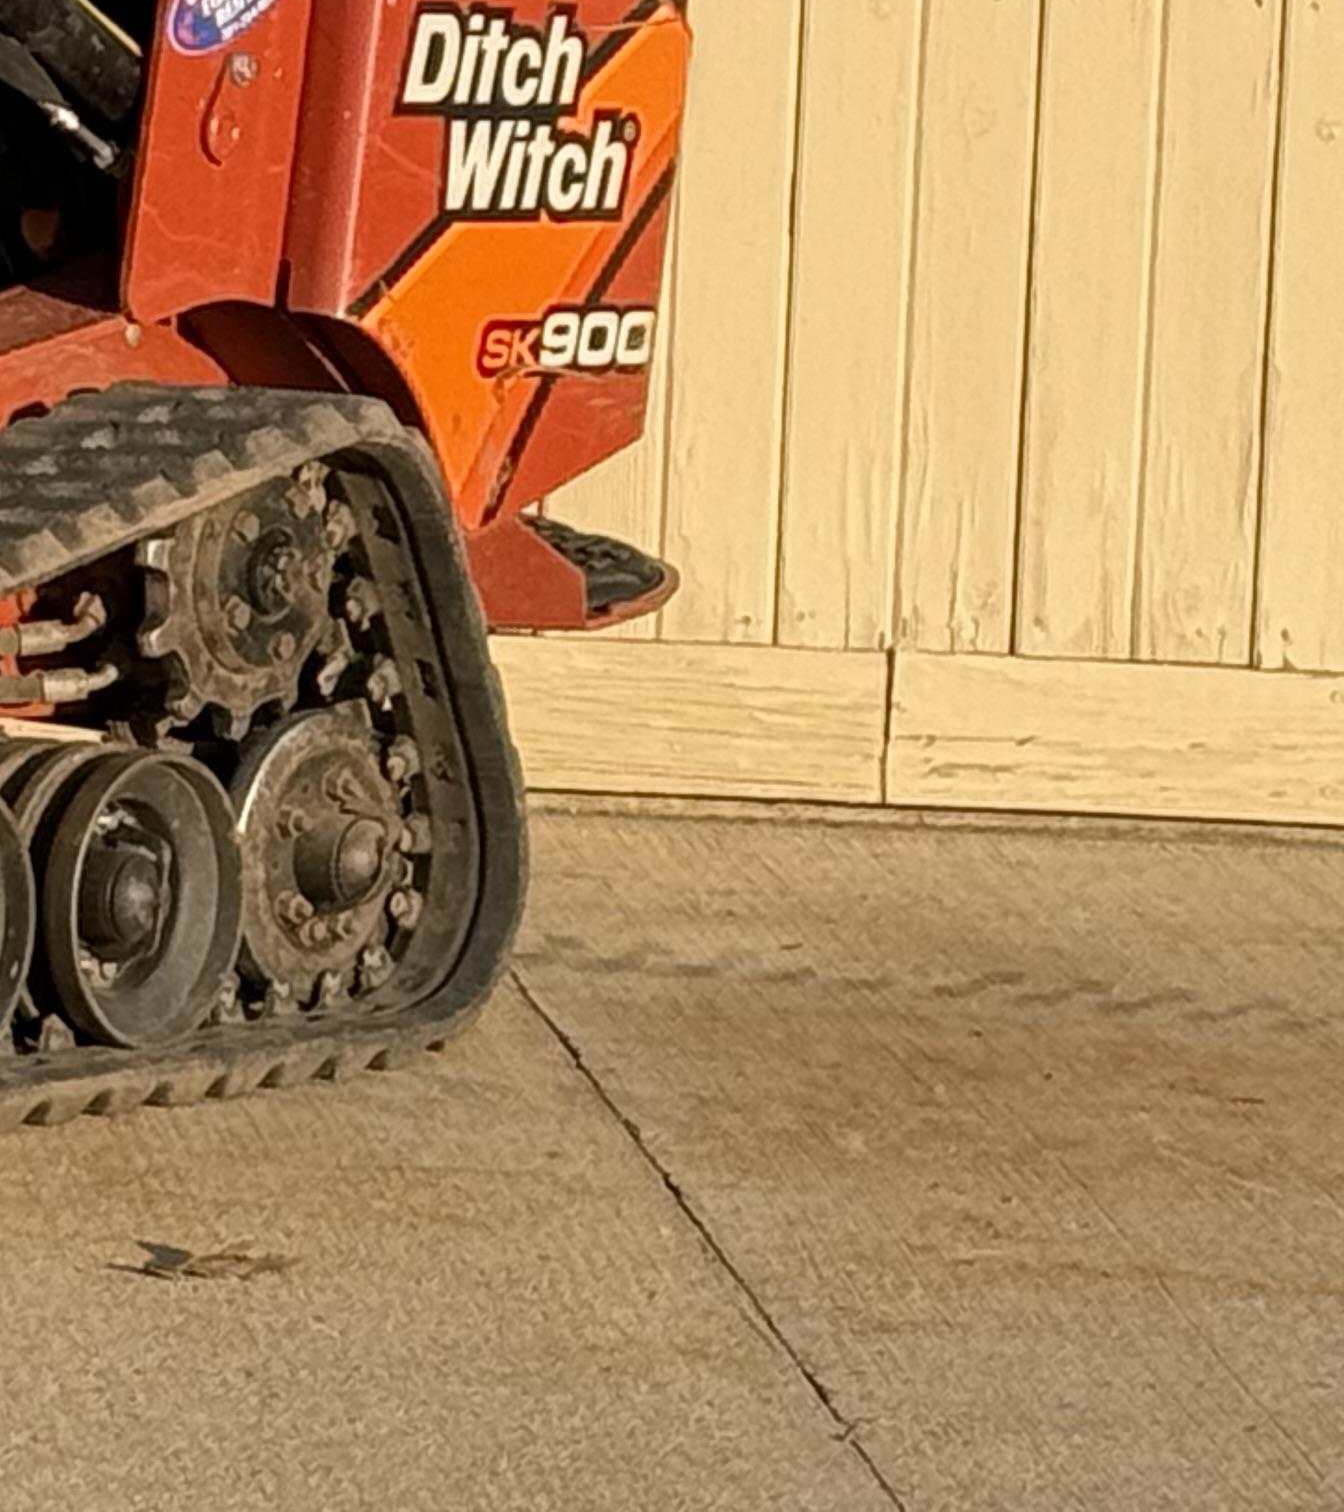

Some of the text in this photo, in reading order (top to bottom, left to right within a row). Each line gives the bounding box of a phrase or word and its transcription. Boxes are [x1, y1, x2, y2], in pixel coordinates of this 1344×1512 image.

[402, 12, 584, 107] Ditch
[446, 118, 628, 212] Witch
[481, 310, 658, 370] SK900
